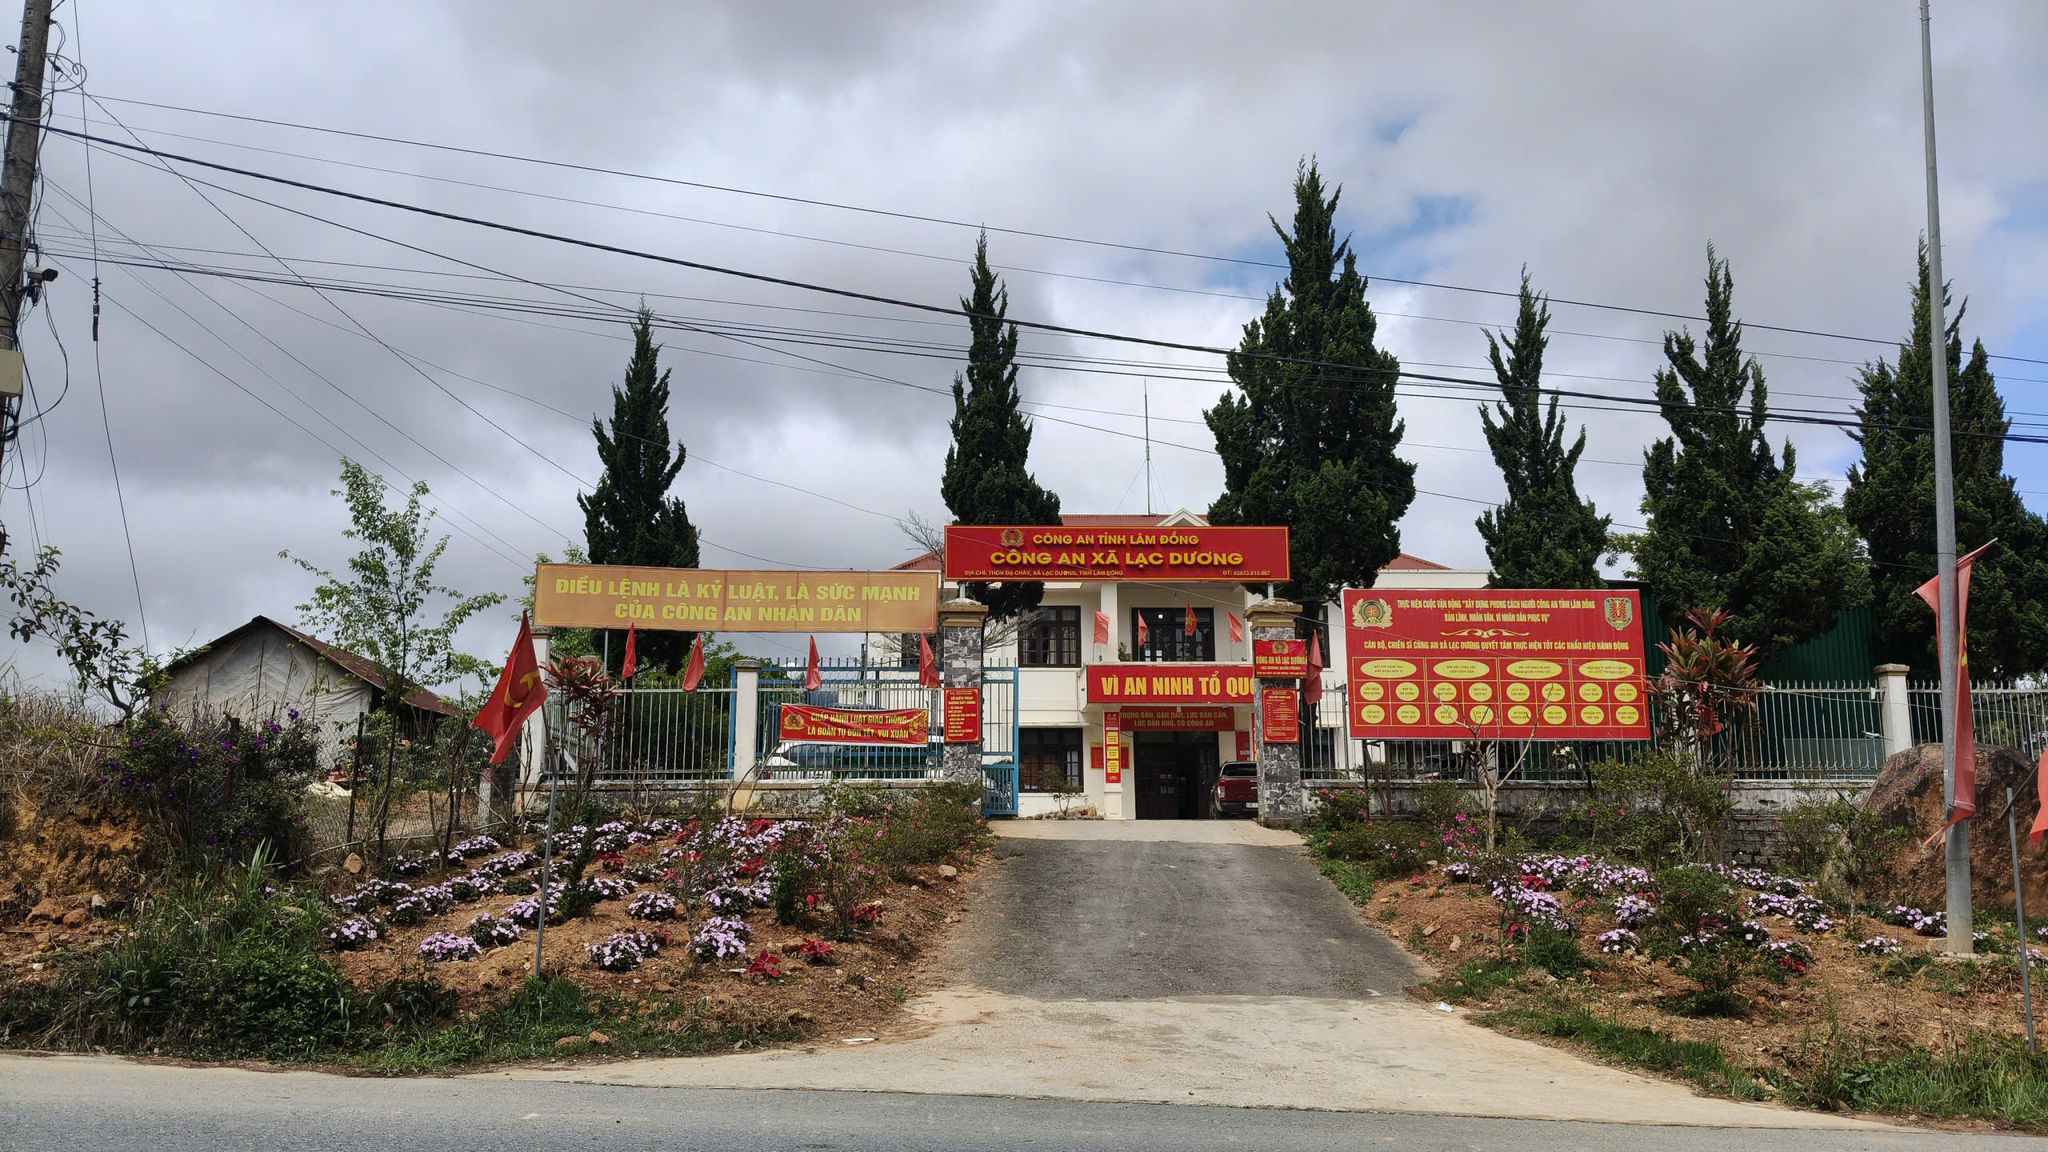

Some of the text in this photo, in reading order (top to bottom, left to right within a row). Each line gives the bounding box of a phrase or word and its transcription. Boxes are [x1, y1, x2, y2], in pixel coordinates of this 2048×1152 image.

[1033, 530, 1200, 545] CÔNG AN TỈNH LÂM ĐỒNG
[990, 549, 1244, 569] CÔNG AN XÃ LẠC DƯƠNG
[555, 576, 921, 603] ĐIỀU LỆNH LÀ KỶ LUẬT, LÀ SỨC MẠNH
[615, 599, 862, 622] CỦA CÔNG AN NHÂN DÂN
[1364, 639, 1376, 650] CÁN
[1388, 639, 1406, 650] CHIẾN
[1413, 639, 1430, 650] CÔNG
[1430, 641, 1439, 650] AN
[1439, 639, 1448, 650] XÃ
[1449, 641, 1460, 651] LẠC
[1460, 640, 1480, 650] DƯƠNG
[1481, 639, 1499, 651] QUYẾT
[1499, 639, 1513, 650] TÂM
[1513, 640, 1528, 651] THỰC
[1529, 639, 1542, 651] HIỆN
[1554, 639, 1567, 650] CÁC
[1613, 640, 1630, 651] ĐỘNG
[1101, 674, 1119, 696] VÌ
[1124, 677, 1147, 696] AN
[1152, 677, 1194, 696] NINH
[1198, 670, 1221, 696] TỔ
[868, 714, 883, 724] GIAO
[890, 728, 909, 739] XUÂN
